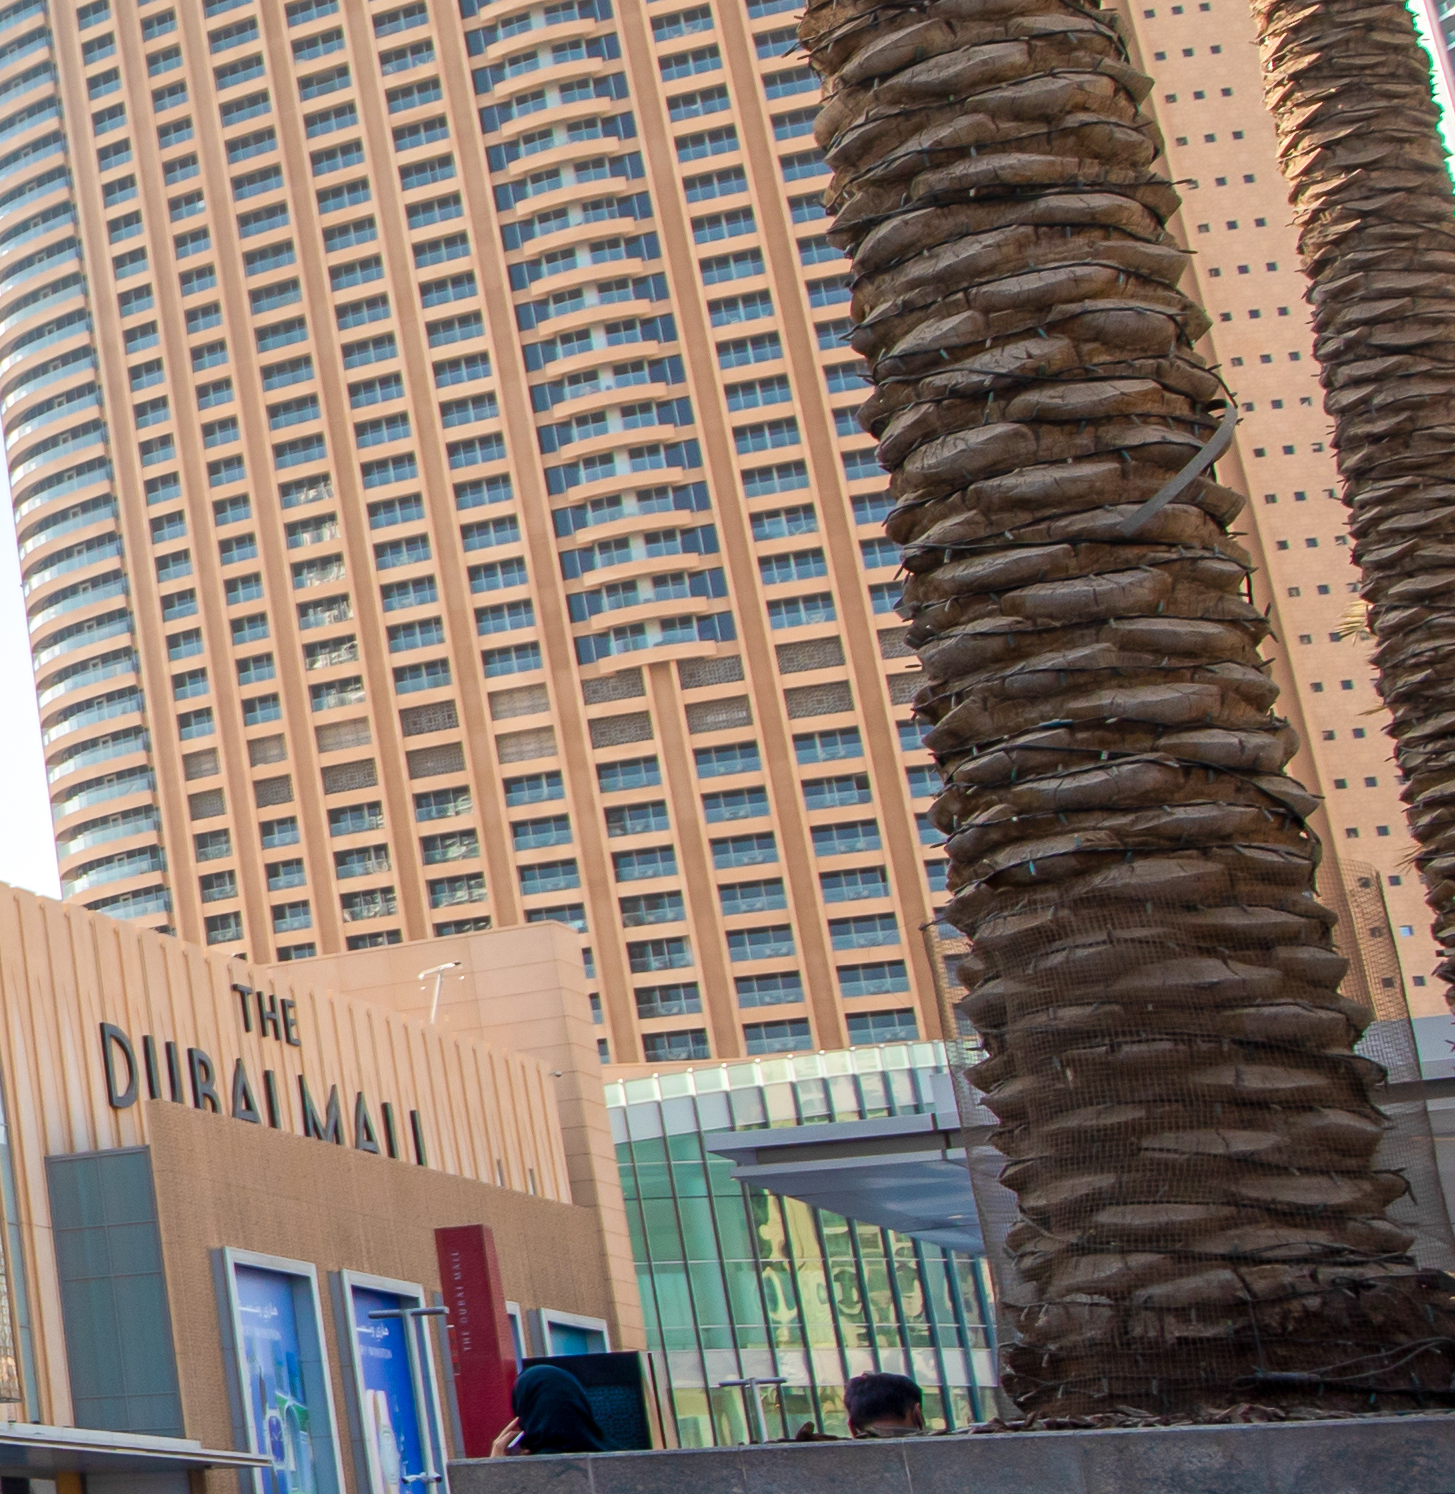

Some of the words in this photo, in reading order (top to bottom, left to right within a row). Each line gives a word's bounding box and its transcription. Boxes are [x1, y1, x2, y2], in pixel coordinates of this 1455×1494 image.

[231, 983, 302, 1047] THE
[99, 1021, 282, 1130] DUBAI
[450, 1251, 462, 1281] MALL
[455, 1285, 468, 1324] DUBAI
[462, 1331, 472, 1352] THE
